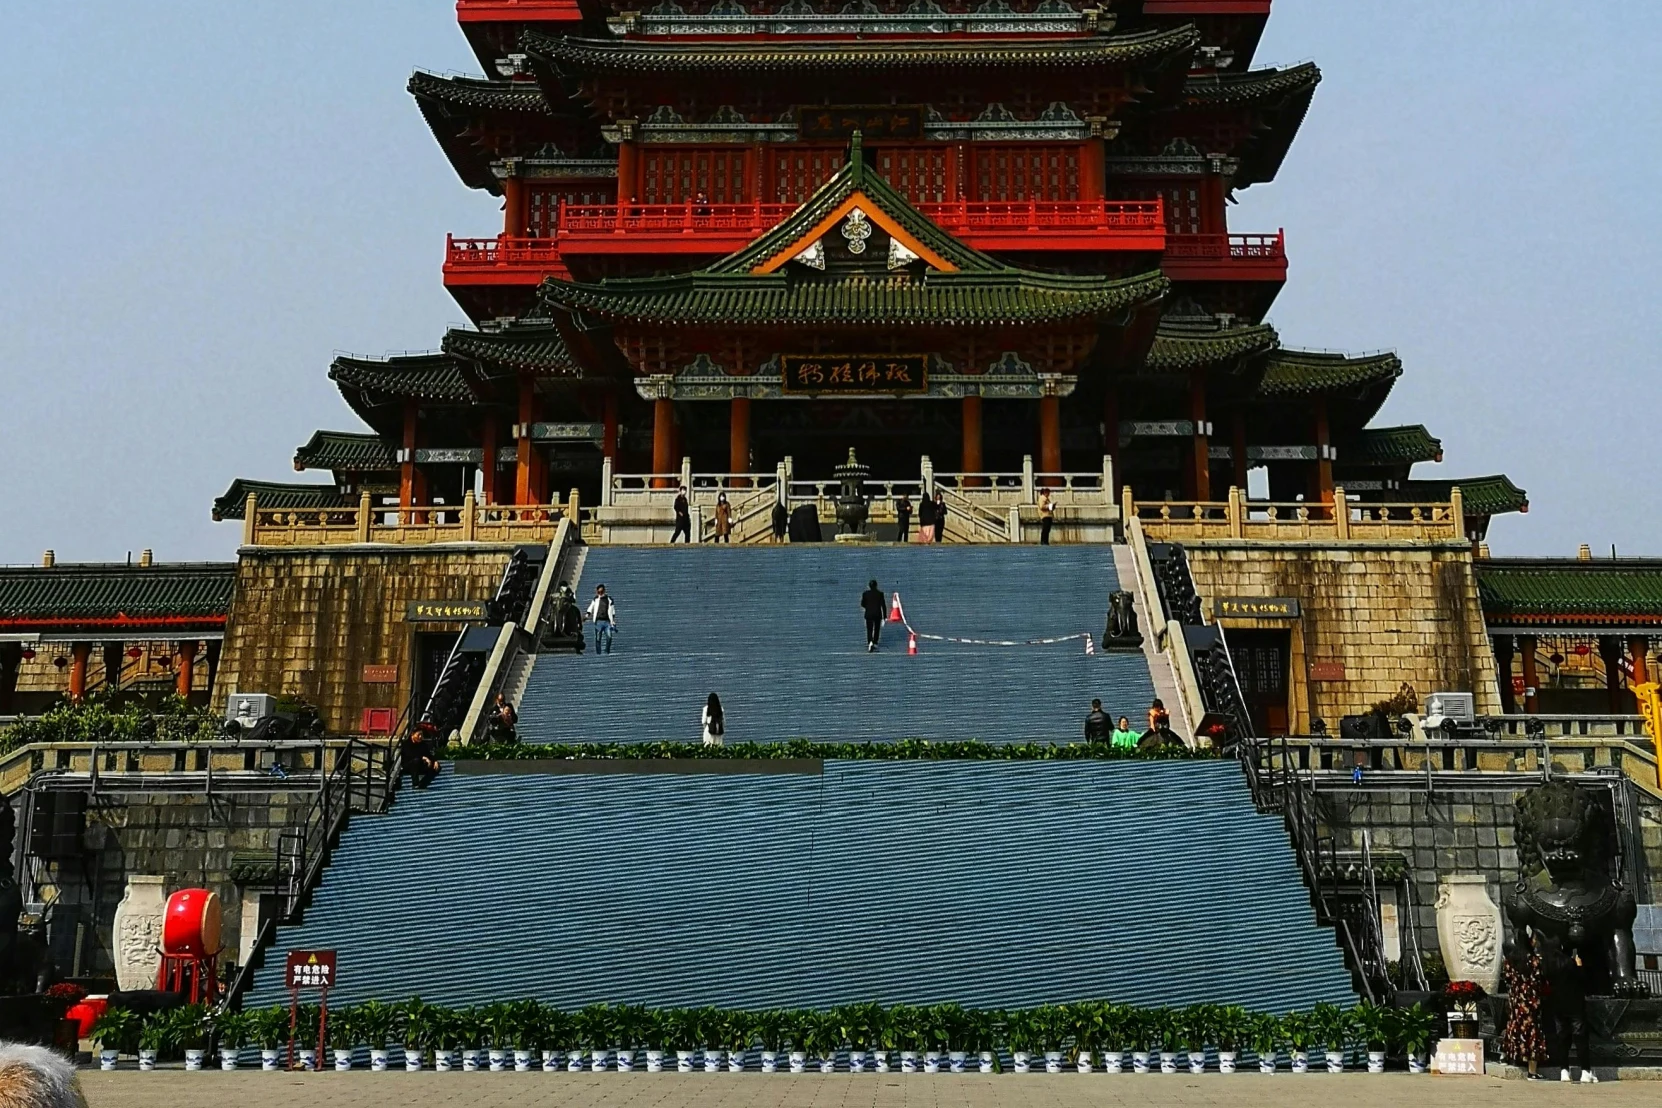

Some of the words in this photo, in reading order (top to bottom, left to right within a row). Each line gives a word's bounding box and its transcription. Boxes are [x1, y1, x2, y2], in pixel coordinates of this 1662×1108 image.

[293, 964, 330, 974] 有电危险
[292, 975, 329, 985] 严禁进入
